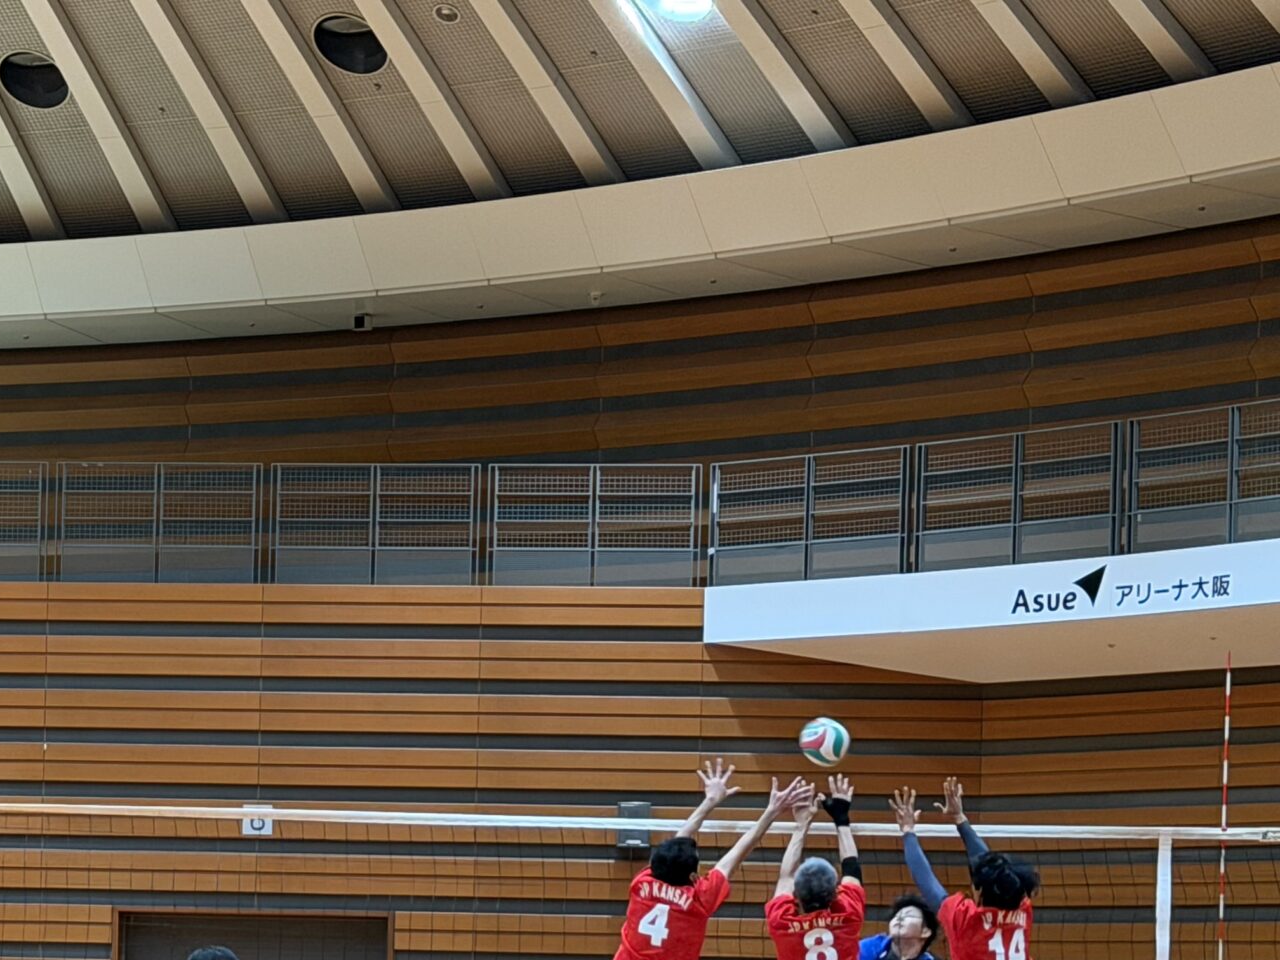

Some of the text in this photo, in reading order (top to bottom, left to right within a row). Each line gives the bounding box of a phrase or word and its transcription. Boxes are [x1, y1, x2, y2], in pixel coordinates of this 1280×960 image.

[1011, 574, 1231, 614] Asue アリーナ大阪
[652, 881, 694, 911] KANSAI
[638, 903, 670, 947] 4
